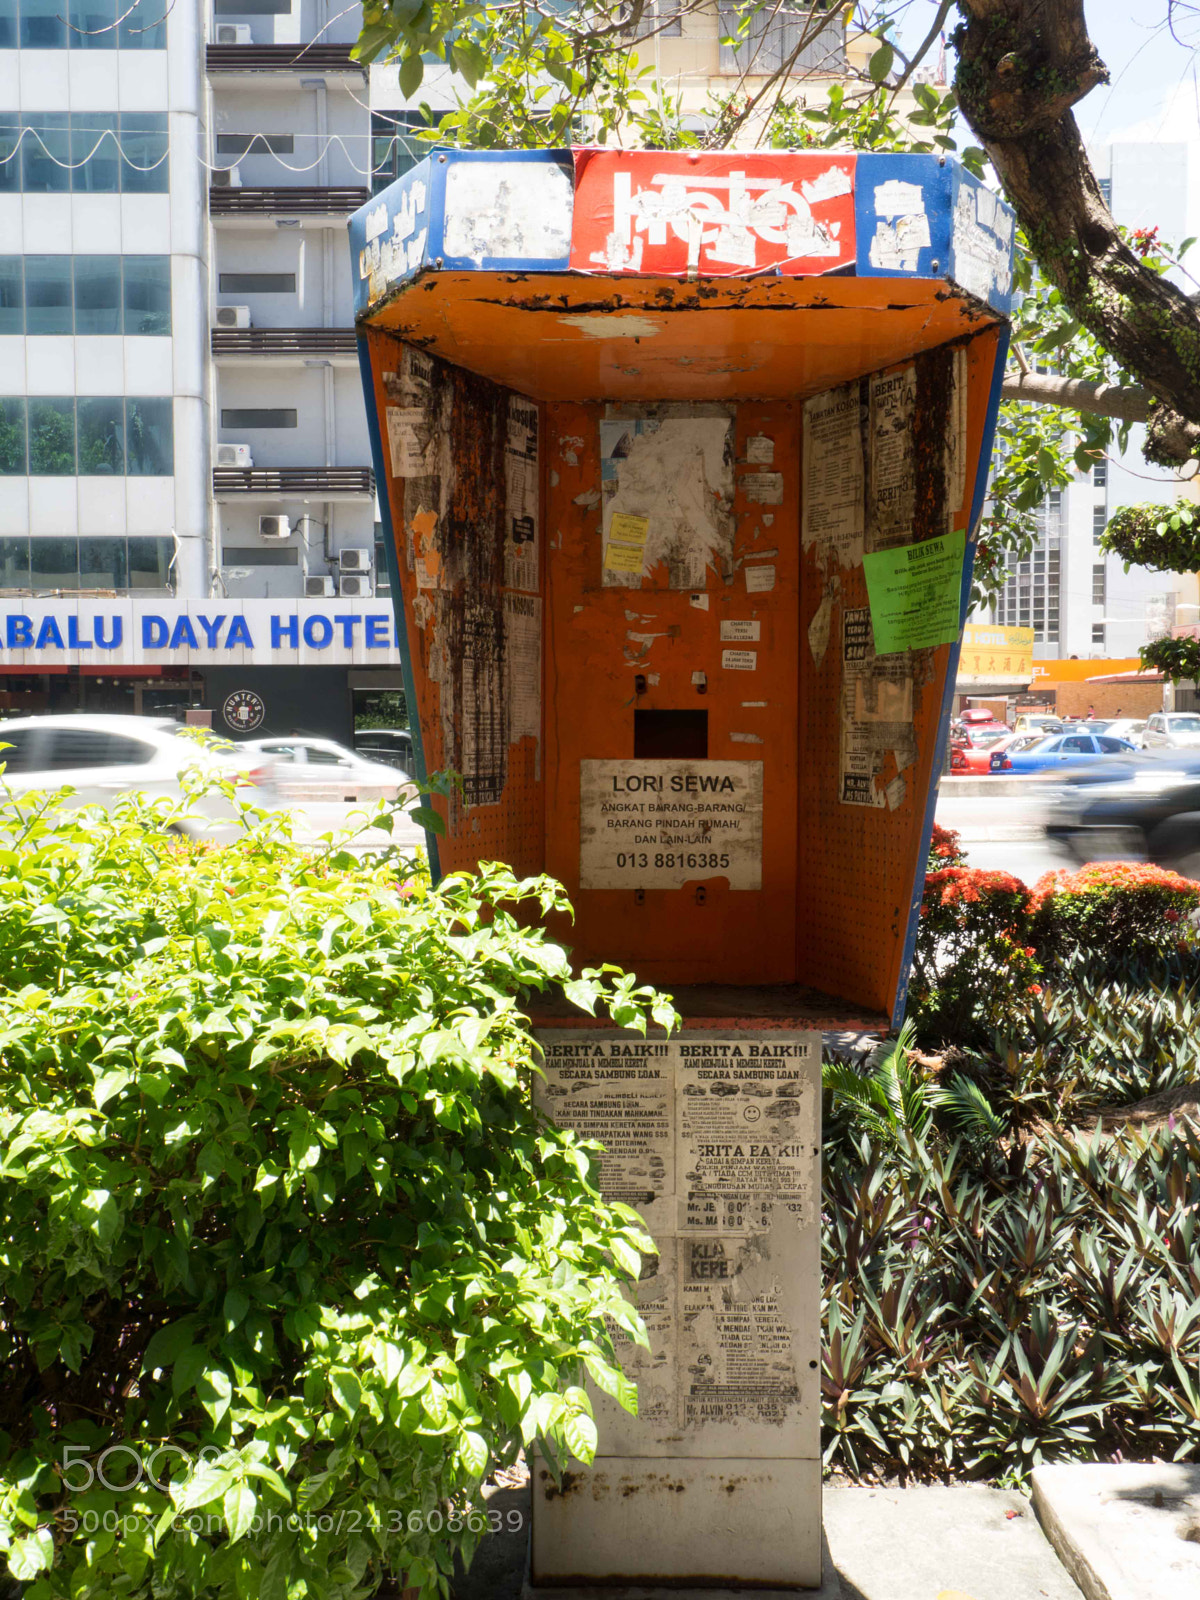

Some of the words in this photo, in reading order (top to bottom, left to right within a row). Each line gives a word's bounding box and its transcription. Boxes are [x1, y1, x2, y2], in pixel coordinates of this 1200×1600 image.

[926, 540, 945, 555] SEWA
[0, 614, 123, 649] BALU
[141, 614, 255, 649] DAYA
[270, 614, 399, 649] HOTE
[974, 632, 1009, 646] HOTEL
[612, 775, 663, 792] LORI
[670, 775, 735, 792] SEWA
[601, 803, 645, 813] ANGKAT
[607, 819, 652, 829] BARANG
[655, 819, 695, 829] PINDAH
[634, 835, 657, 845] DAN
[659, 835, 712, 845] LAIN-LAIN
[616, 853, 649, 868] 013
[654, 853, 730, 868] 8816385
[610, 1045, 669, 1057] BAIK!!!
[680, 1045, 743, 1057] BERITA
[749, 1045, 808, 1057] BAIK!!!
[683, 1058, 700, 1068] KAMI
[559, 1070, 593, 1079] SECARA
[594, 1070, 635, 1079] SAMBUNG
[697, 1071, 731, 1080] SECARA
[733, 1070, 775, 1080] SAMBUNG
[580, 1130, 631, 1138] MENDAPATKAN
[632, 1130, 653, 1138] WANG
[697, 1145, 745, 1157] ERITA
[687, 1203, 701, 1212] Mr.
[687, 1217, 703, 1226] Ms.
[700, 1404, 724, 1416] ALVIN
